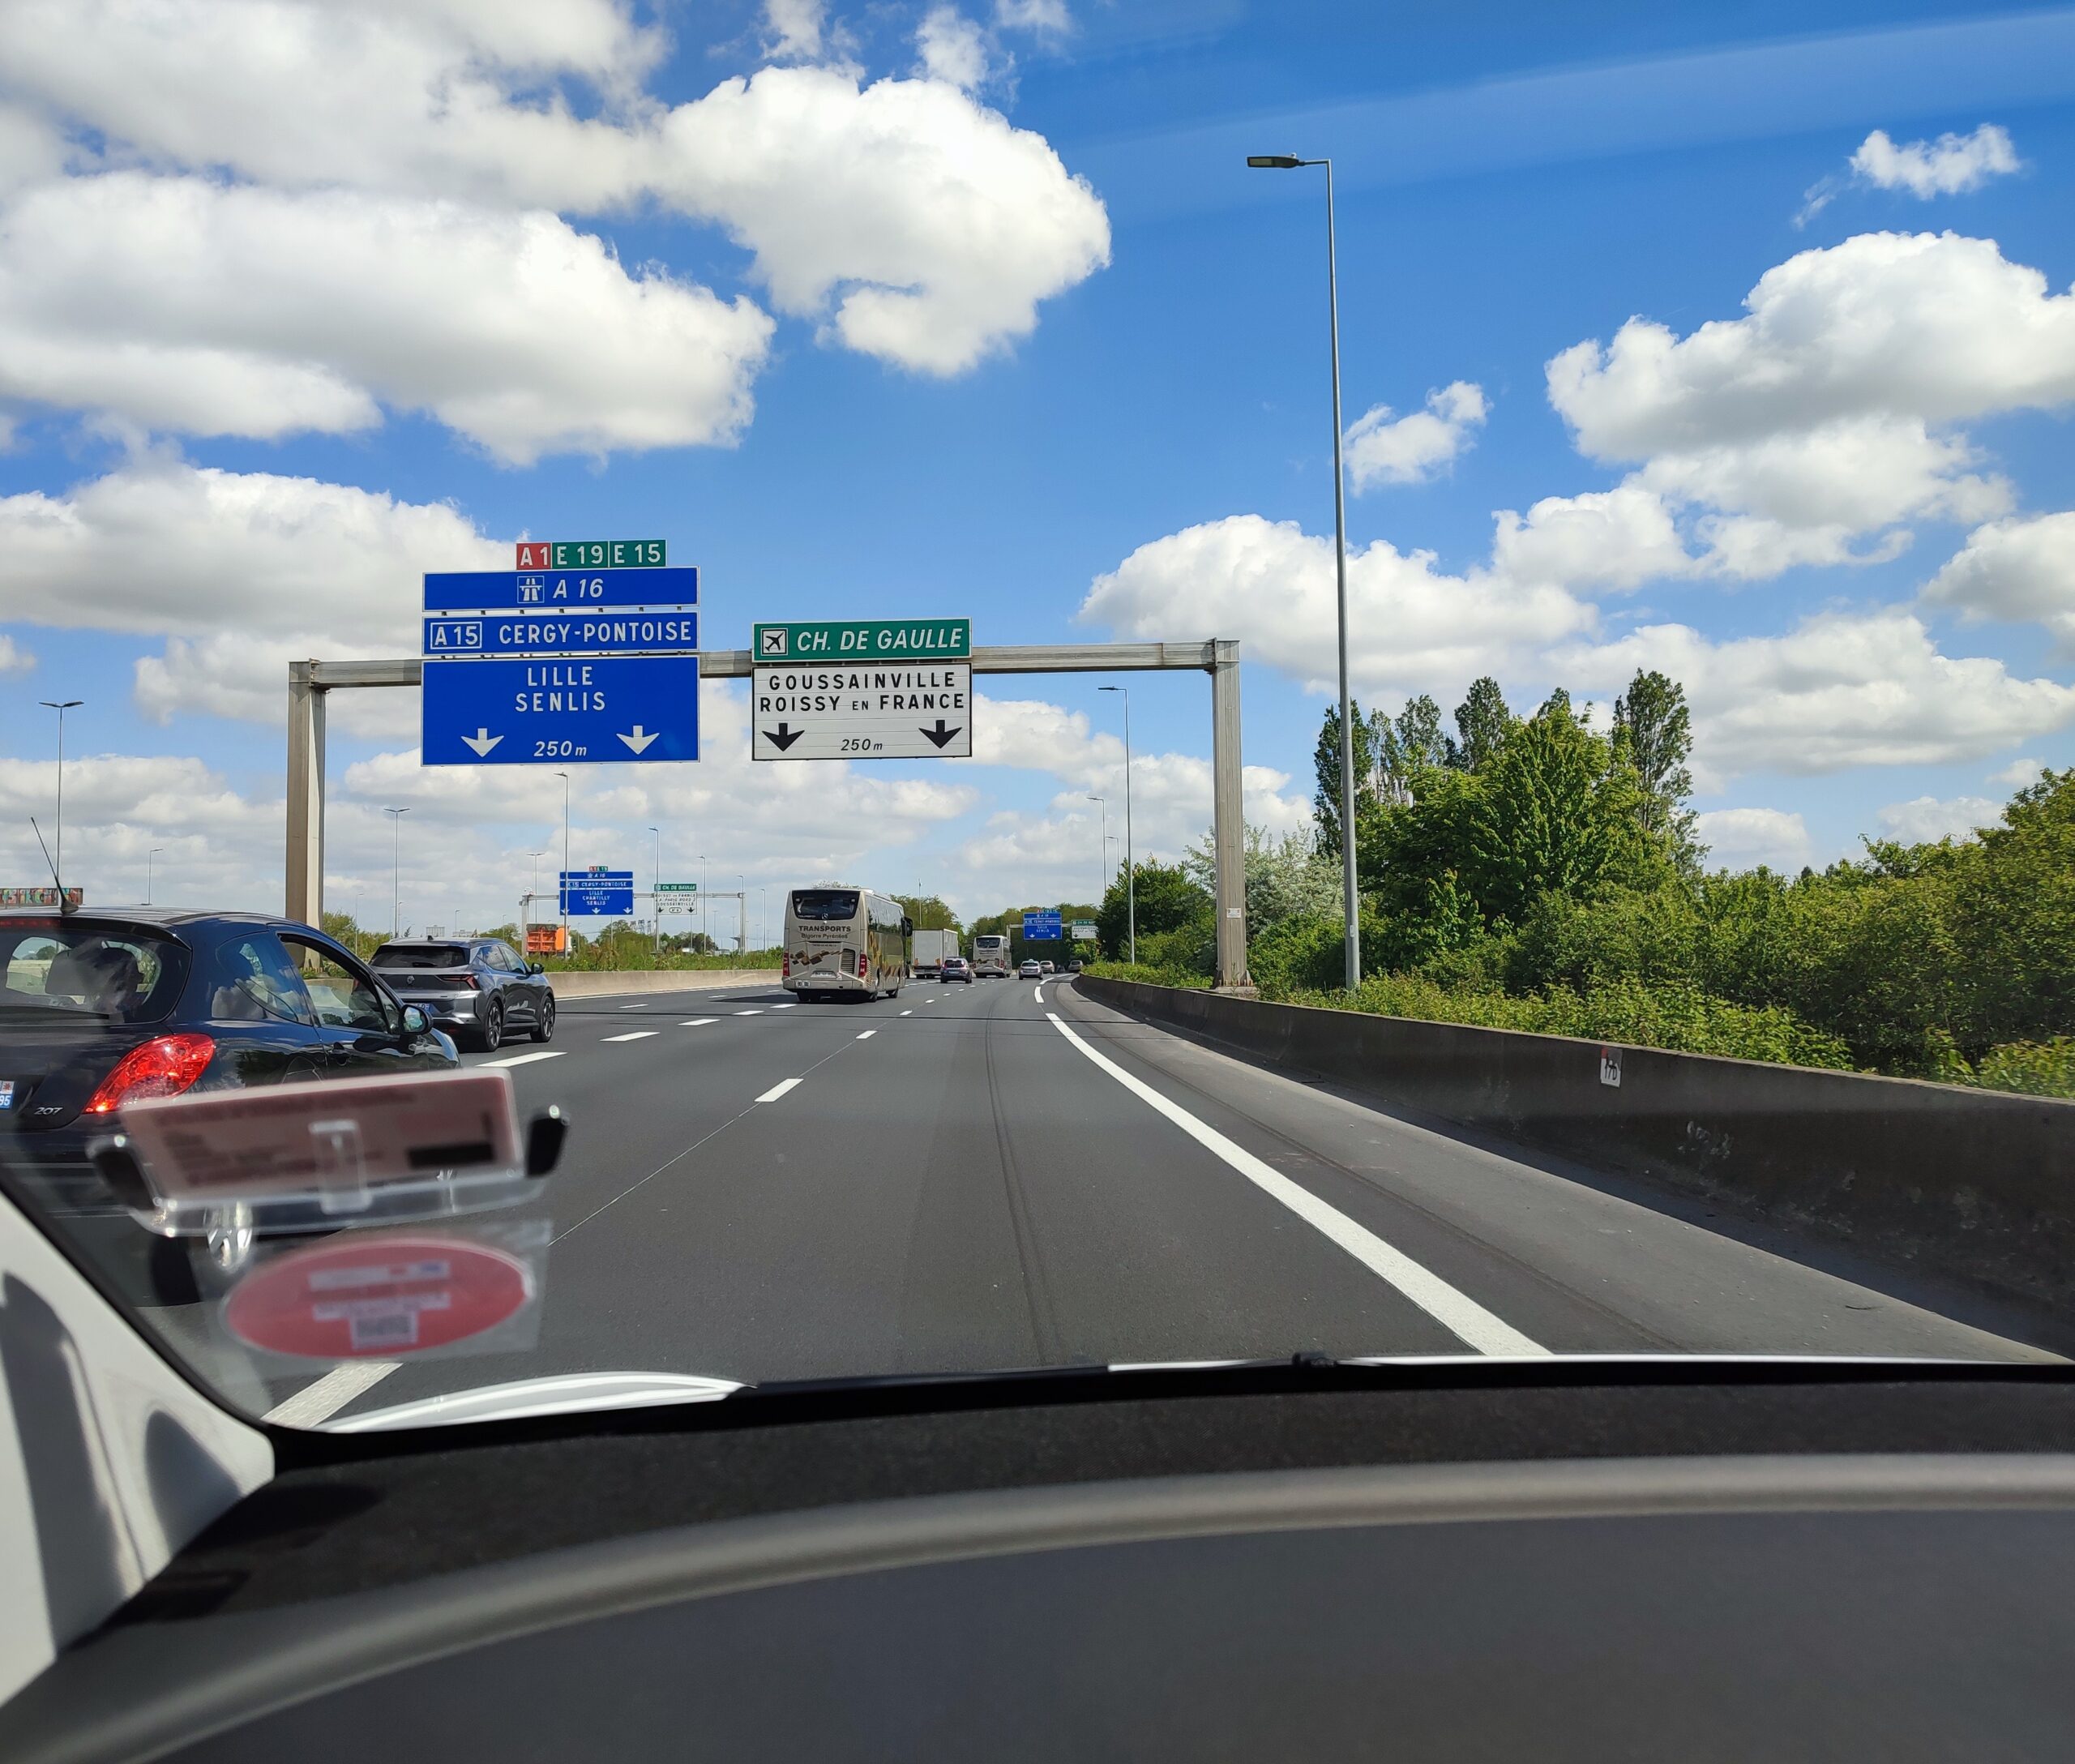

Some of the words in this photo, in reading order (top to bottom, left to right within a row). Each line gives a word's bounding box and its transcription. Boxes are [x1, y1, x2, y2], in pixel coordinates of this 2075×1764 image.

[557, 546, 567, 565] E
[577, 545, 603, 564] 19
[614, 544, 625, 563] E
[635, 543, 661, 563] 15
[580, 578, 604, 598] 16
[499, 621, 691, 644] CERGY-PONTOISE
[797, 631, 831, 651] CH.
[840, 630, 869, 650] DE
[877, 627, 963, 649] GAULLE
[528, 666, 593, 687] LILLE
[769, 671, 955, 691] GOUSSAINVILLE
[515, 691, 605, 712] SENLIS
[760, 696, 841, 712] ROISSY
[852, 700, 869, 711] EN
[879, 693, 964, 710] FRANCE
[533, 740, 572, 757] 250
[575, 747, 587, 756] m
[841, 739, 871, 751] 250
[873, 743, 883, 751] m
[33, 1107, 64, 1115] 207
